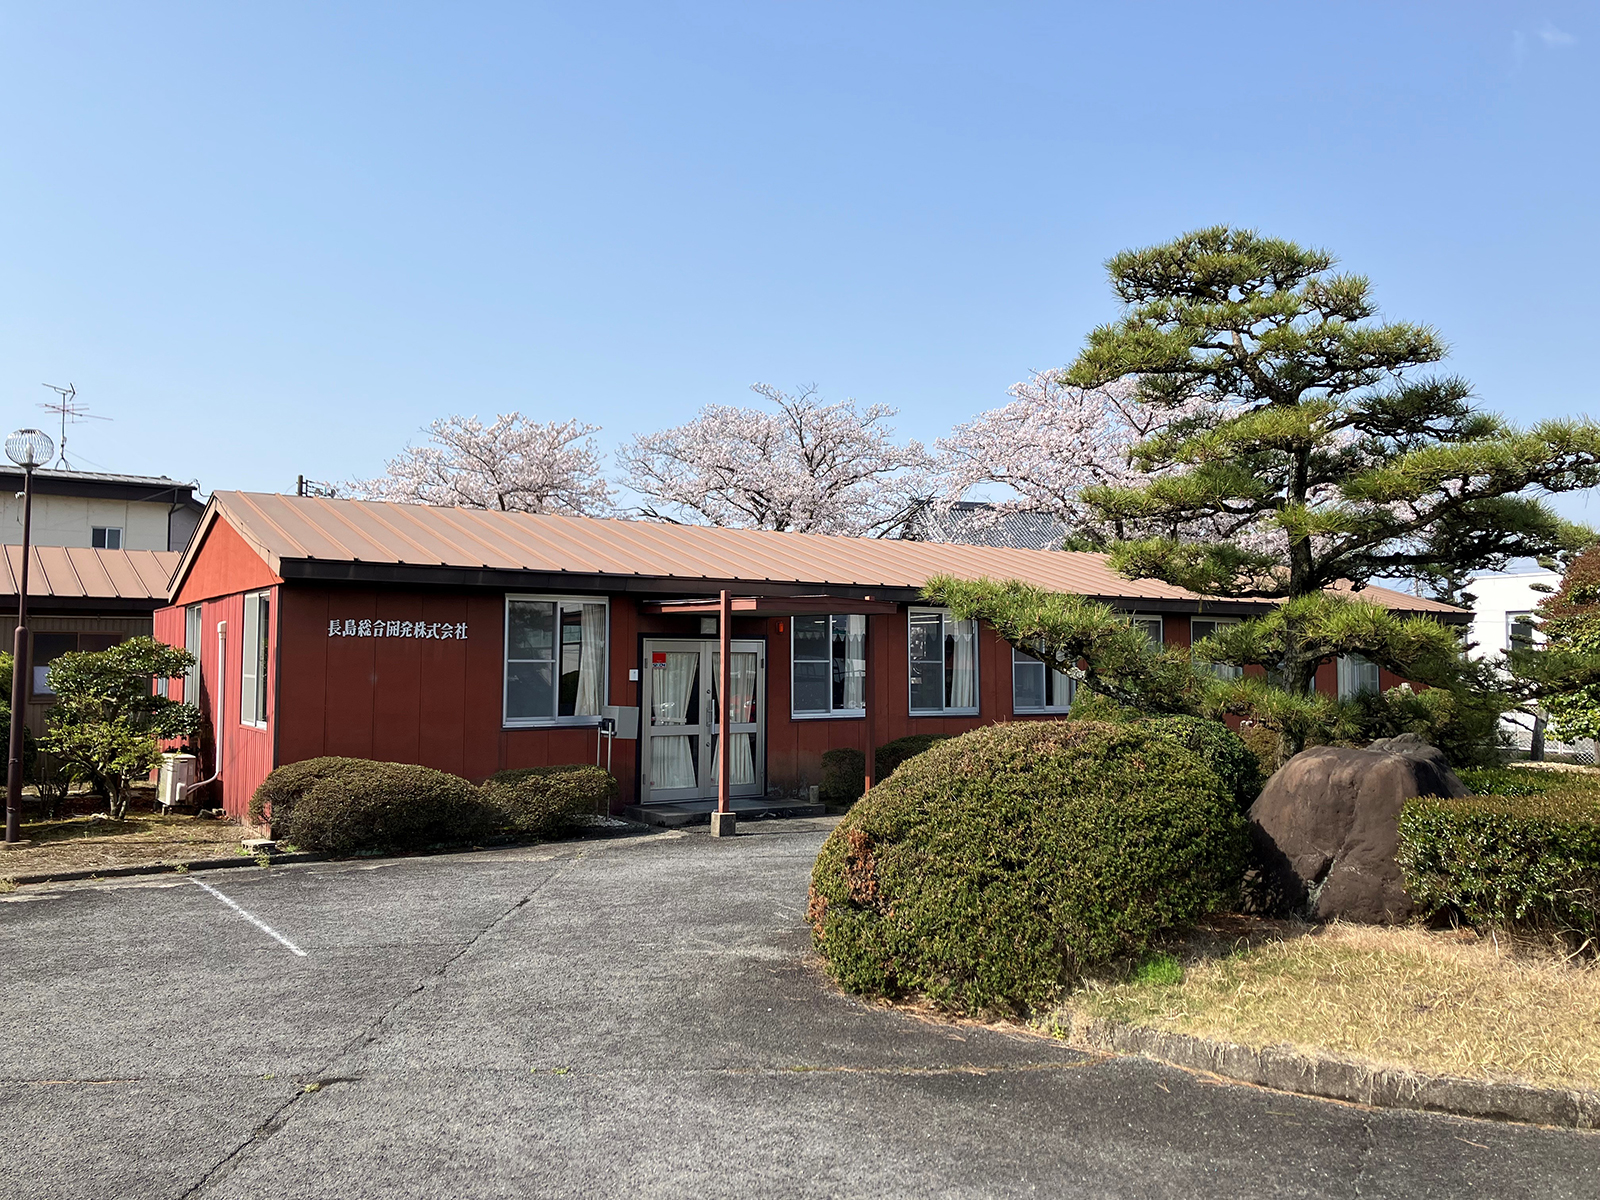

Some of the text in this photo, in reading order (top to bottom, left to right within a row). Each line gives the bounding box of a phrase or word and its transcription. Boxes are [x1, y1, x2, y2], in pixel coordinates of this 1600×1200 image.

[328, 619, 468, 640] 長島総合開発株式会社
